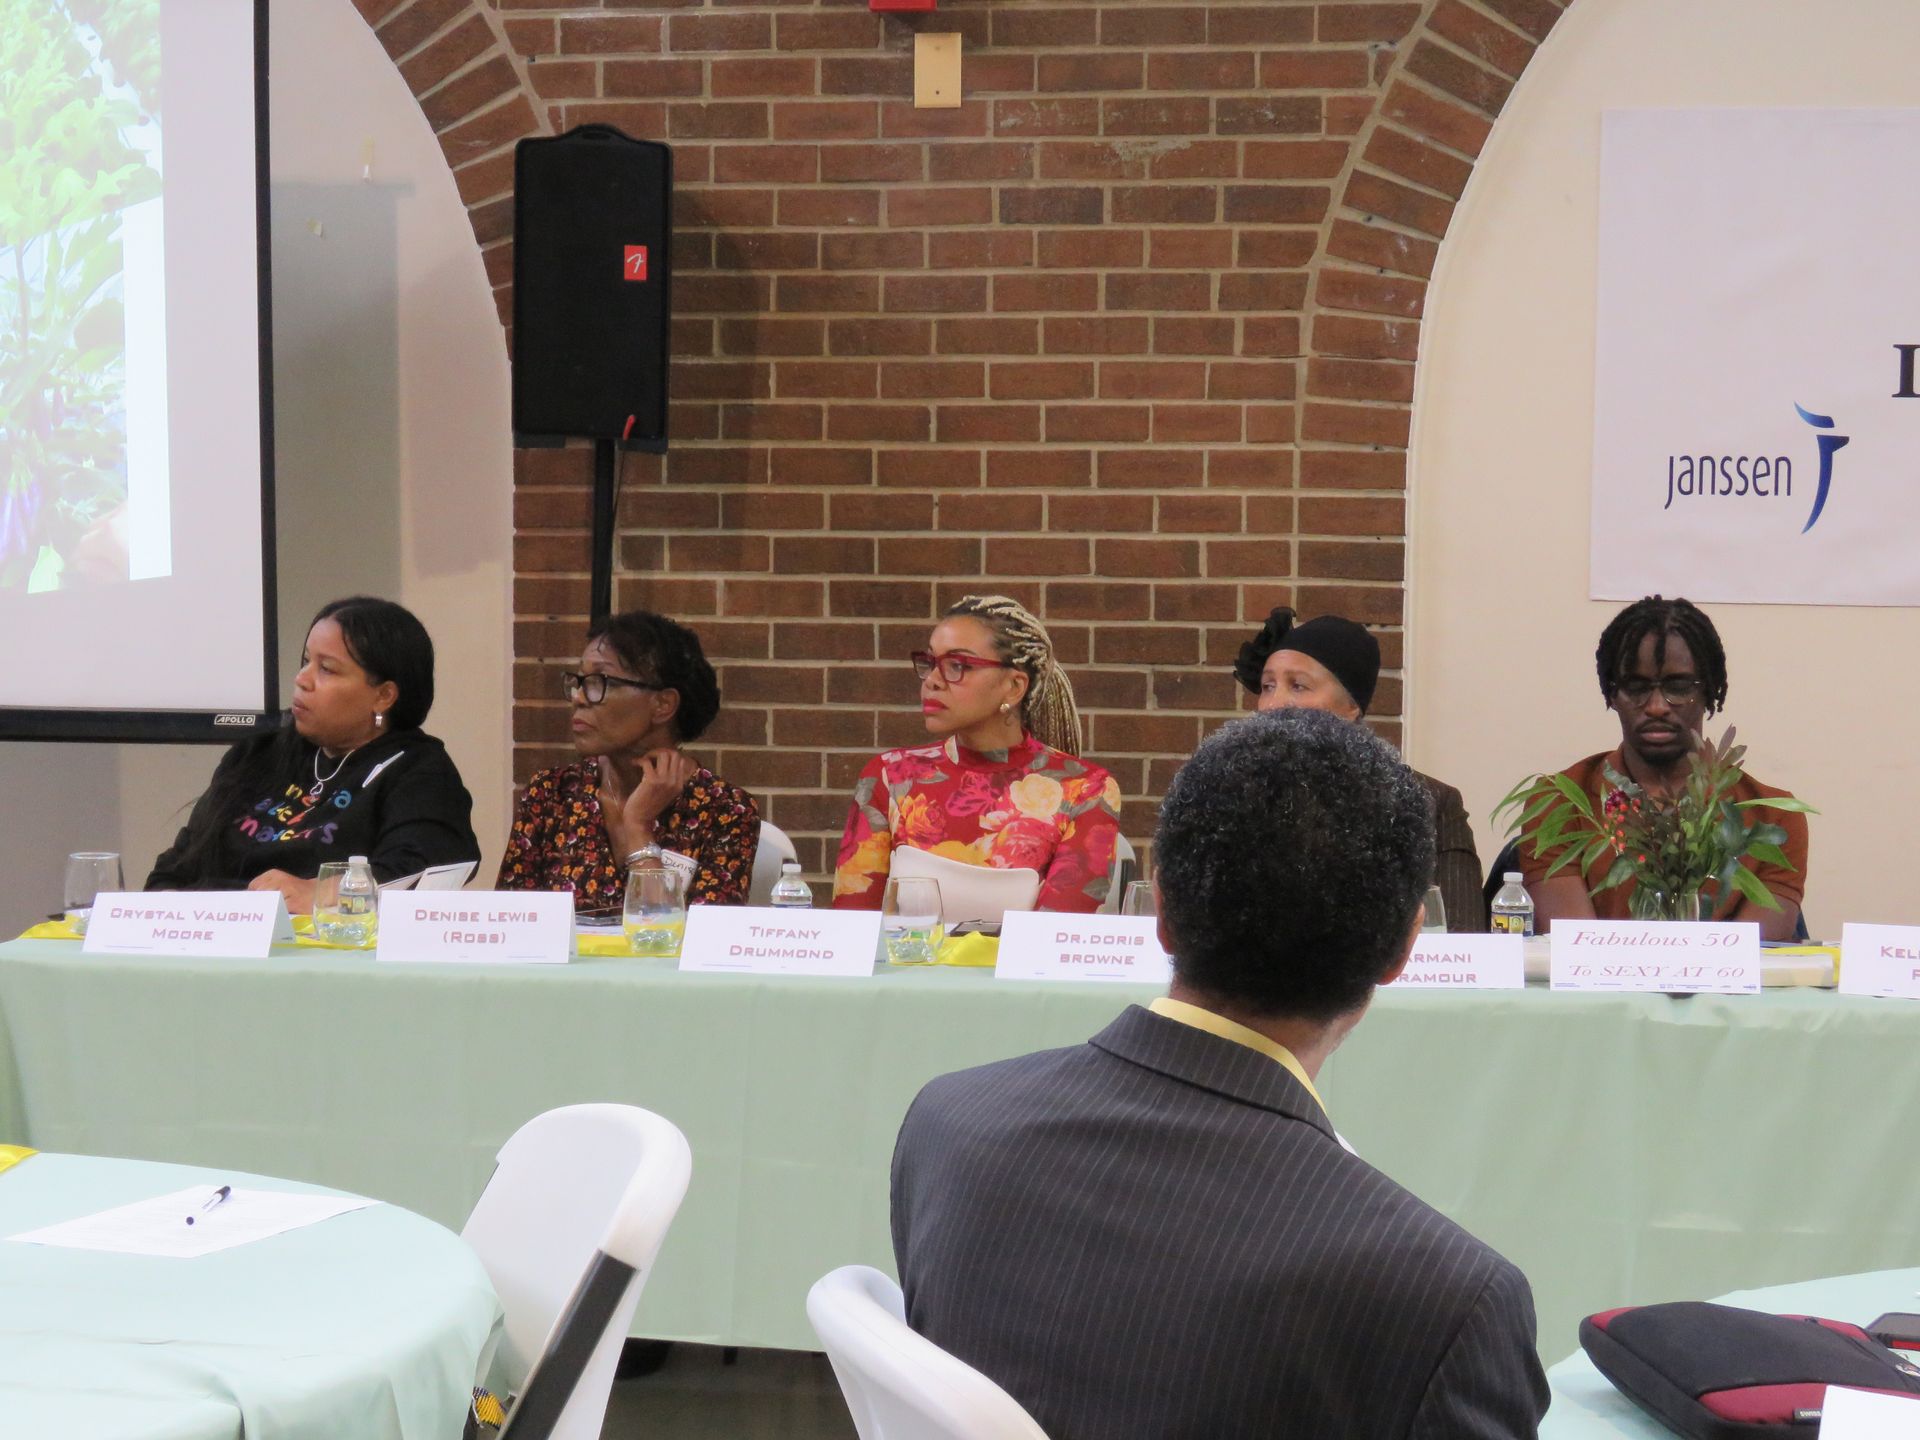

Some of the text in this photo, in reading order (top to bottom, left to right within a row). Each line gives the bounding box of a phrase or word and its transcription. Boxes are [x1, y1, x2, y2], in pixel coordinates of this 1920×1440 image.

[1664, 455, 1792, 510] janssen
[111, 908, 263, 922] CRYSTAL VAUGHN
[415, 910, 538, 922] DENISE LEWIS
[152, 928, 214, 940] MOORE
[443, 931, 506, 944] (ROSS)
[749, 926, 821, 939] TIFFANY
[1573, 931, 1740, 947] Fabulous 50
[729, 945, 834, 959] DRUMMOND
[1880, 945, 1920, 959] KEL
[1060, 954, 1135, 965] BROWNE
[1569, 965, 1745, 977] To SEXY AT 60
[1395, 973, 1477, 983] RAMOUR
